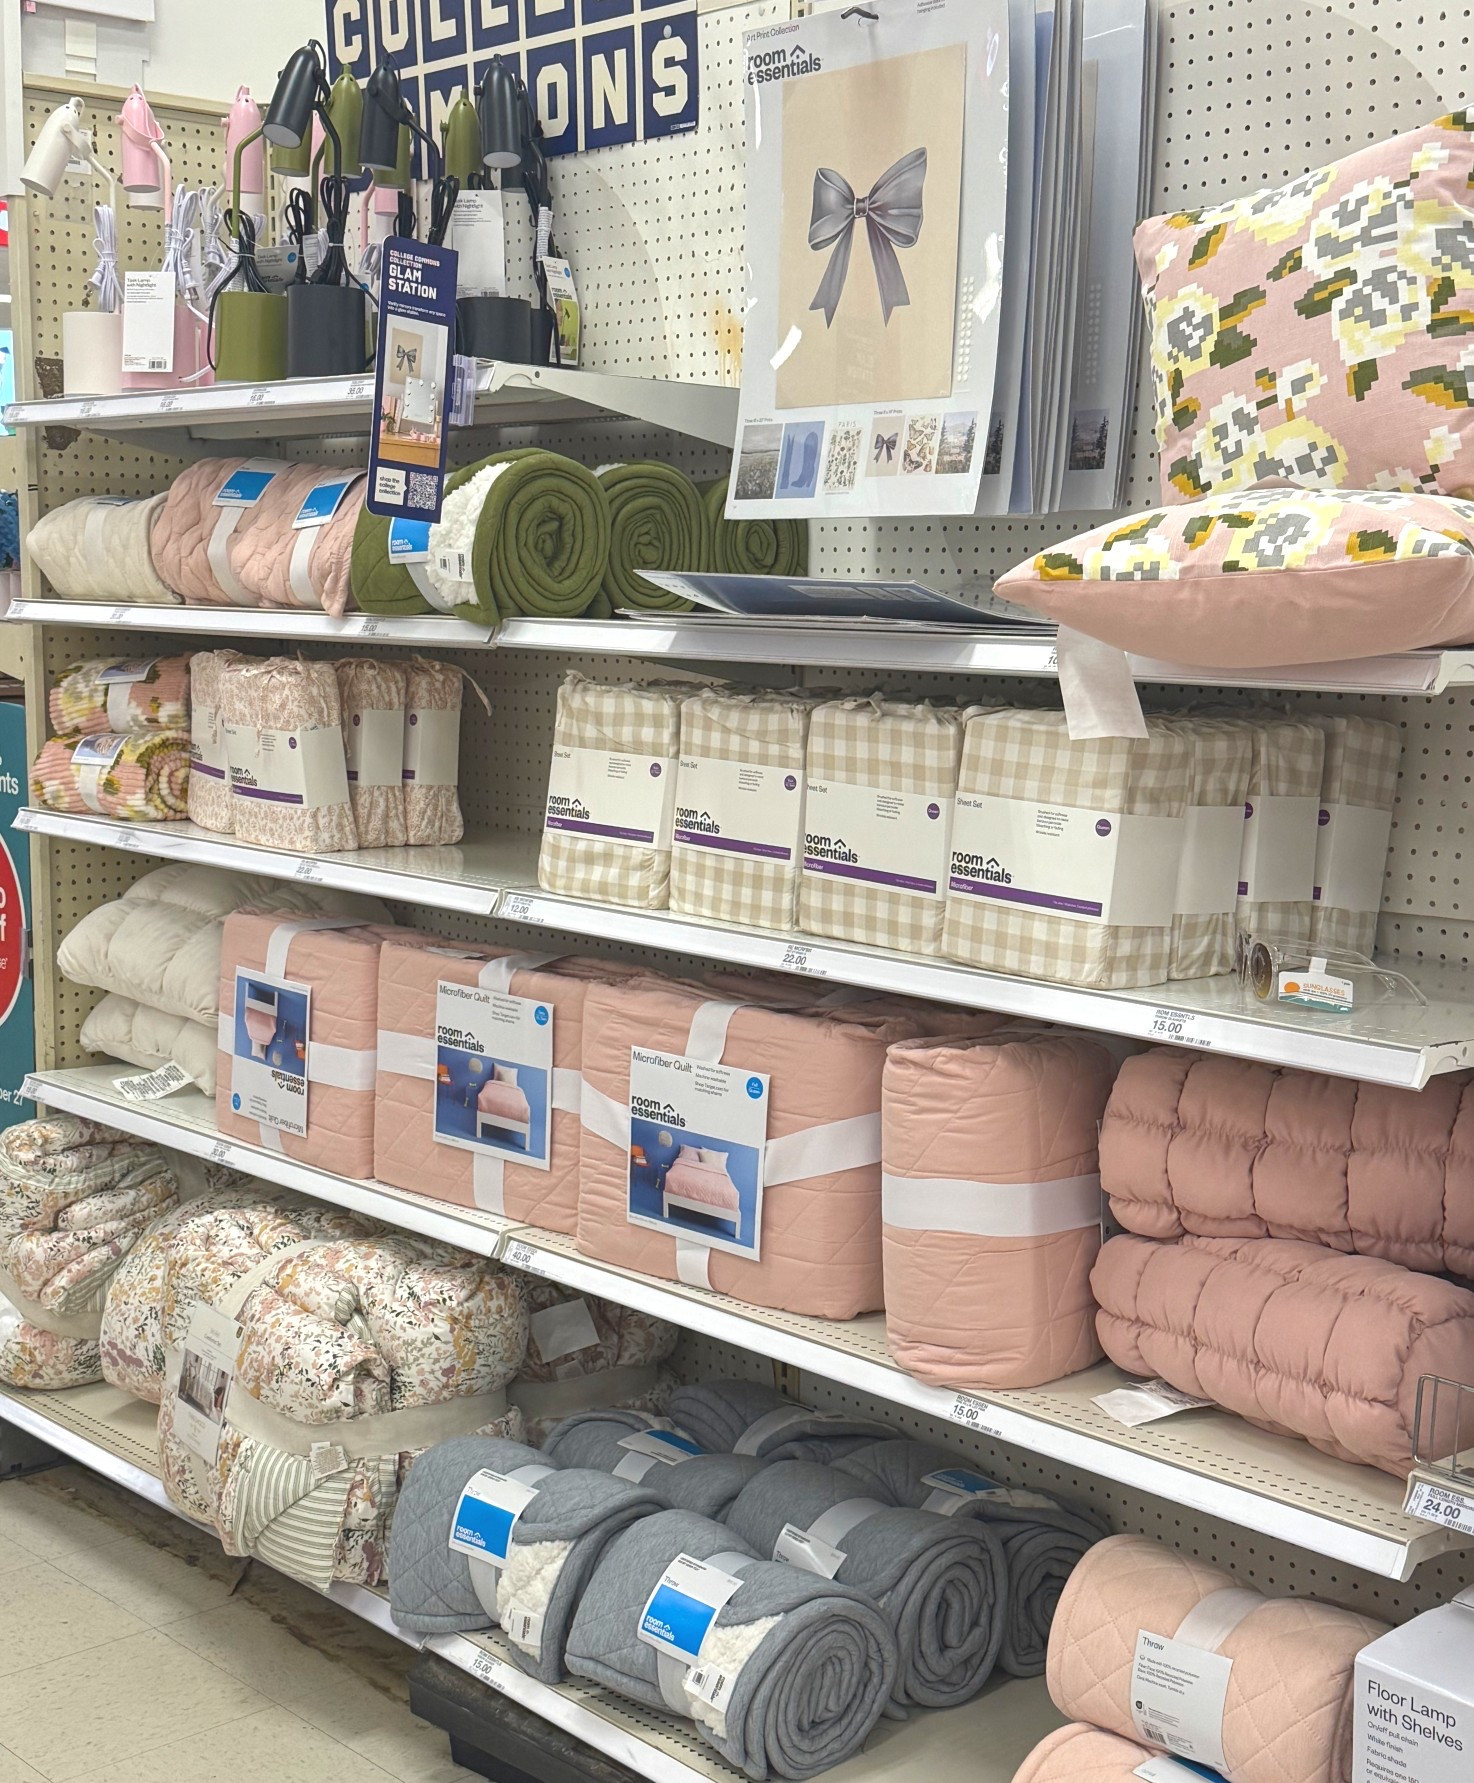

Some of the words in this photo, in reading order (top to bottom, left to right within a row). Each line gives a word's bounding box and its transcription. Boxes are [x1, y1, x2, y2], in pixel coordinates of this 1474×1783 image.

[747, 32, 756, 43] Art
[757, 28, 770, 41] Print
[770, 24, 800, 38] Collection
[748, 48, 786, 70] room
[747, 52, 821, 85] essentials
[389, 256, 422, 269] COLLECTION
[390, 250, 413, 260] COLLEGE
[415, 255, 440, 267] COMMONS
[389, 264, 422, 282] GLAM
[388, 278, 437, 300] STATION
[379, 482, 396, 490] college
[379, 488, 401, 496] collection
[807, 784, 818, 793] heet
[818, 785, 828, 794] Set
[549, 795, 570, 807] room
[957, 798, 972, 808] Sheet
[972, 800, 983, 809] Set
[547, 805, 590, 820] essentials
[676, 807, 698, 820] room
[675, 817, 720, 834] essentials
[805, 833, 831, 847] oom
[804, 861, 824, 870] icrofiber
[952, 851, 983, 867] room
[951, 862, 1012, 884] essentials
[950, 881, 973, 891] Microfiber
[511, 905, 529, 914] 12.00
[782, 953, 807, 965] 22.00
[439, 984, 473, 1001] Microfiber
[473, 992, 490, 1004] Quilt
[1303, 983, 1345, 996] SUNGLASSES
[437, 1025, 463, 1039] room
[1153, 1019, 1182, 1033] 15.00
[437, 1034, 485, 1053] essentials
[632, 1050, 673, 1068] Microfiber
[673, 1059, 693, 1074] Quilt
[272, 1070, 304, 1087] essentials
[286, 1083, 304, 1096] room
[631, 1094, 661, 1111] room
[631, 1106, 686, 1128] essentials
[512, 1251, 531, 1263] 40.00
[957, 1394, 972, 1402] ROOM
[953, 1404, 978, 1420] 15.00
[1430, 1488, 1451, 1498] ROOM
[1423, 1498, 1461, 1519] 24.00
[456, 1525, 474, 1536] room
[455, 1531, 486, 1548] essentials
[663, 1575, 680, 1588] Throw
[646, 1615, 663, 1629] room
[644, 1622, 675, 1641] essentials
[1143, 1636, 1165, 1651] Throw
[473, 1659, 492, 1674] 15.00
[1368, 1679, 1407, 1707] Floor
[1410, 1696, 1456, 1729] Lamp
[1367, 1703, 1398, 1725] with
[1401, 1714, 1463, 1752] Shelves
[1368, 1721, 1388, 1734] On/off
[1389, 1731, 1401, 1740] pull
[1401, 1735, 1419, 1747] chain
[1367, 1733, 1386, 1747] White
[1386, 1741, 1403, 1754] finish
[1367, 1745, 1387, 1760] Fabric
[1387, 1755, 1407, 1768] shade
[1366, 1758, 1394, 1776] Requires
[1394, 1770, 1407, 1781] one
